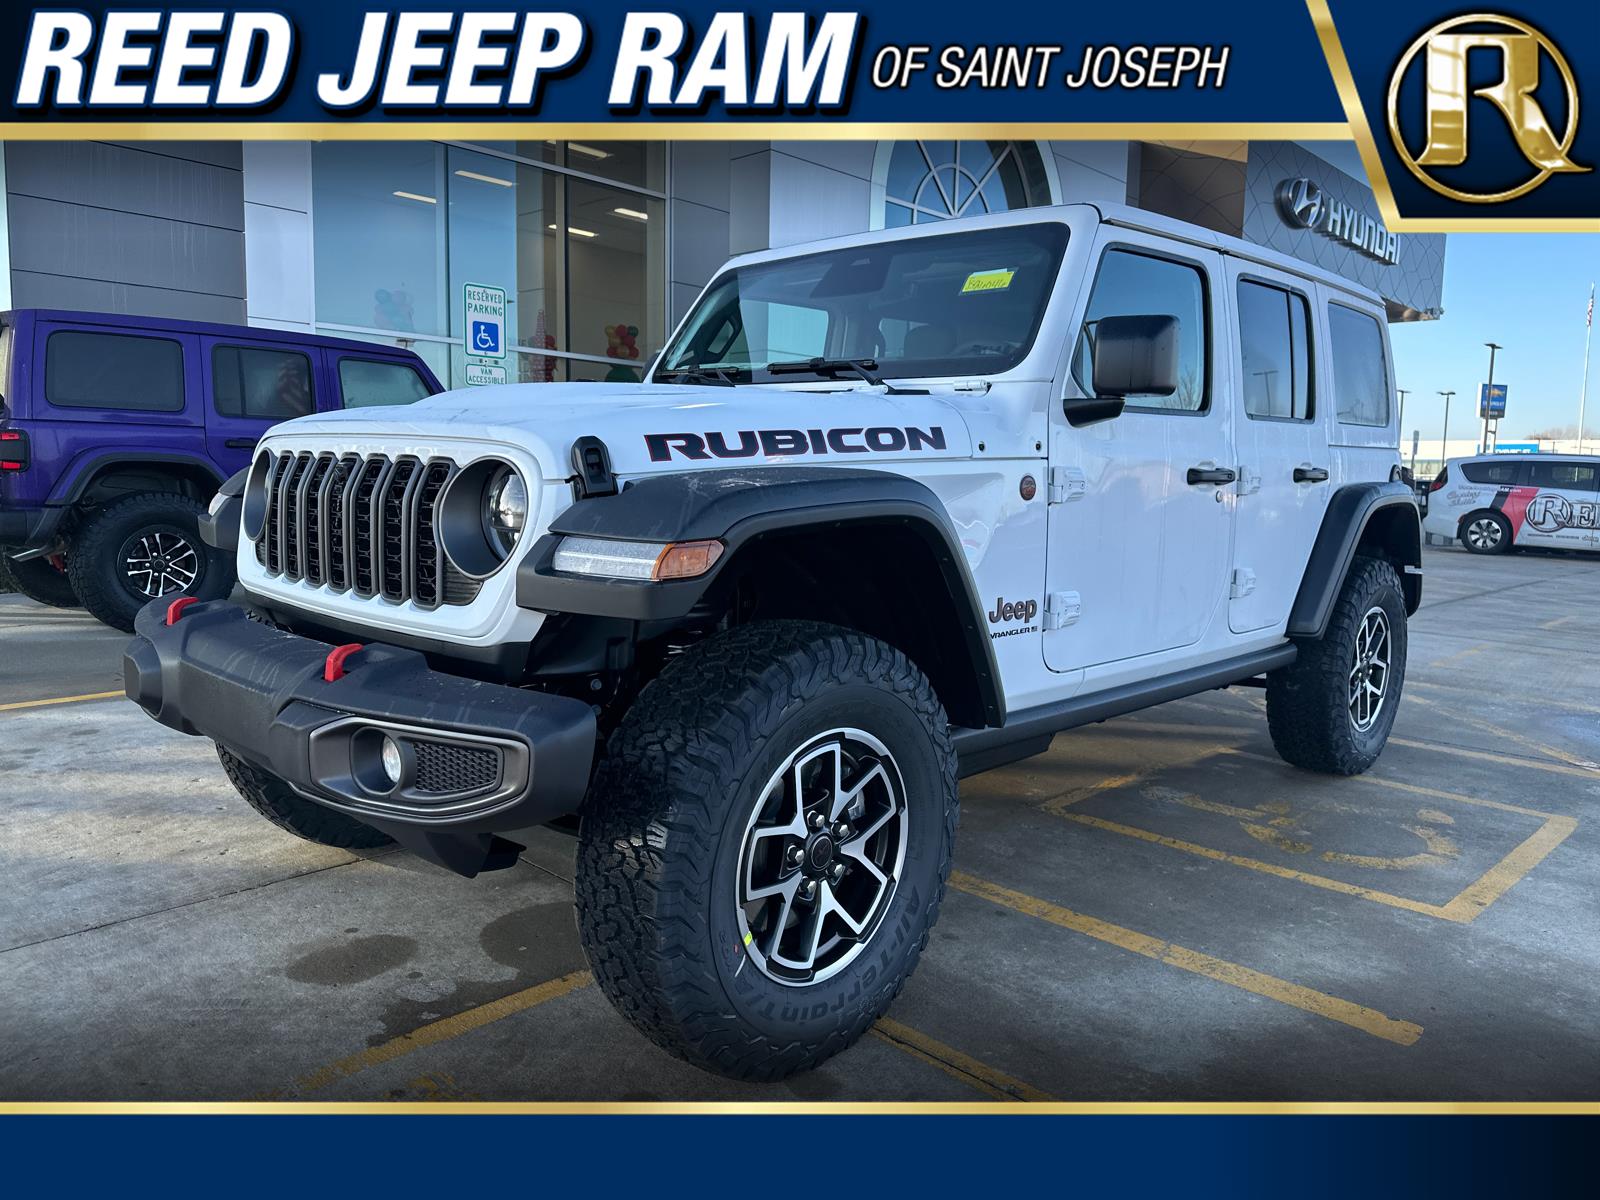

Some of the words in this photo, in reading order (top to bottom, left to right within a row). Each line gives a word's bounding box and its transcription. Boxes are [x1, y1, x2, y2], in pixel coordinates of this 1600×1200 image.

[1328, 197, 1400, 265] HYUNDAI
[467, 290, 503, 304] RESERVED
[467, 303, 503, 317] PARKING
[480, 367, 493, 376] VAN
[468, 375, 505, 385] ACCESSIBLE
[643, 426, 948, 463] RUBICON
[988, 596, 1038, 624] Jeep
[989, 626, 1031, 640] WRANGLER
